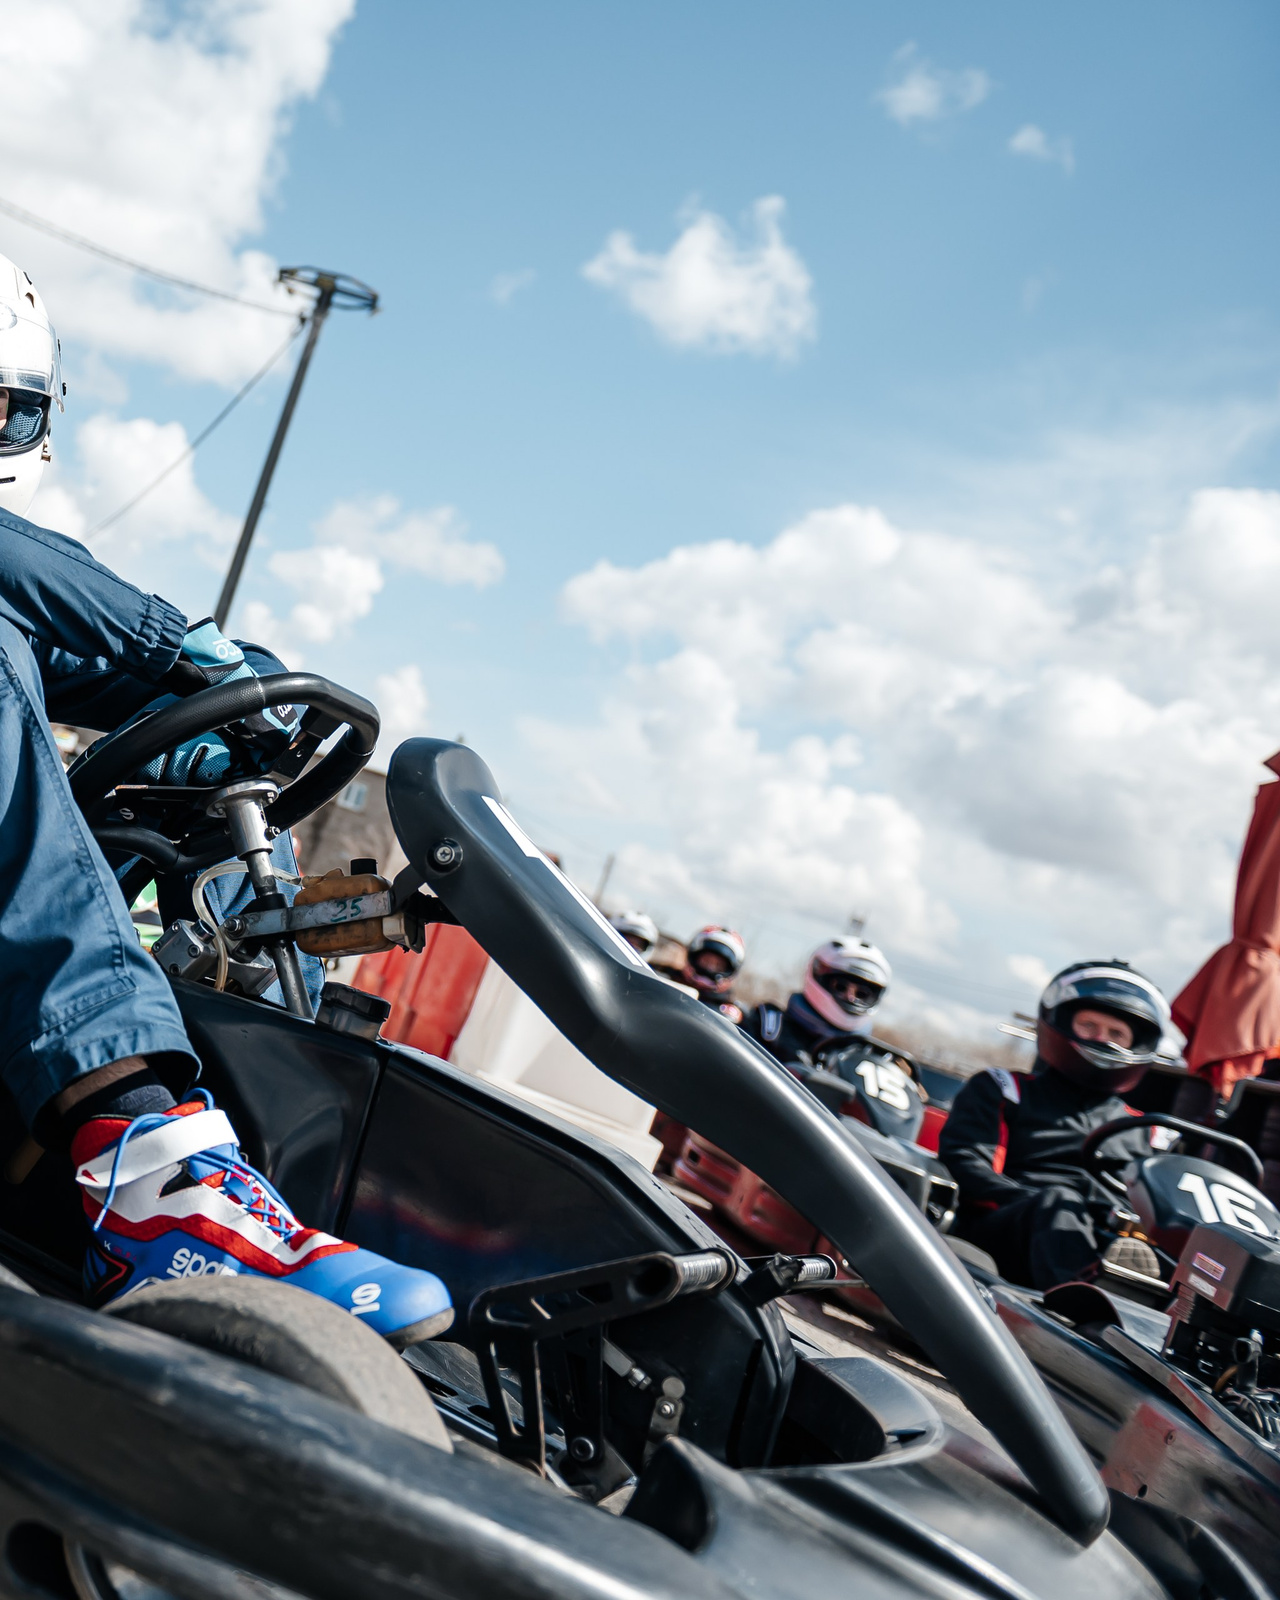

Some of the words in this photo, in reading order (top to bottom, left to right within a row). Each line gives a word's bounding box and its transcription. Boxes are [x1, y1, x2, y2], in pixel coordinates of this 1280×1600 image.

[330, 897, 364, 923] 25
[854, 1060, 910, 1110] 15
[1177, 1172, 1272, 1238] 16
